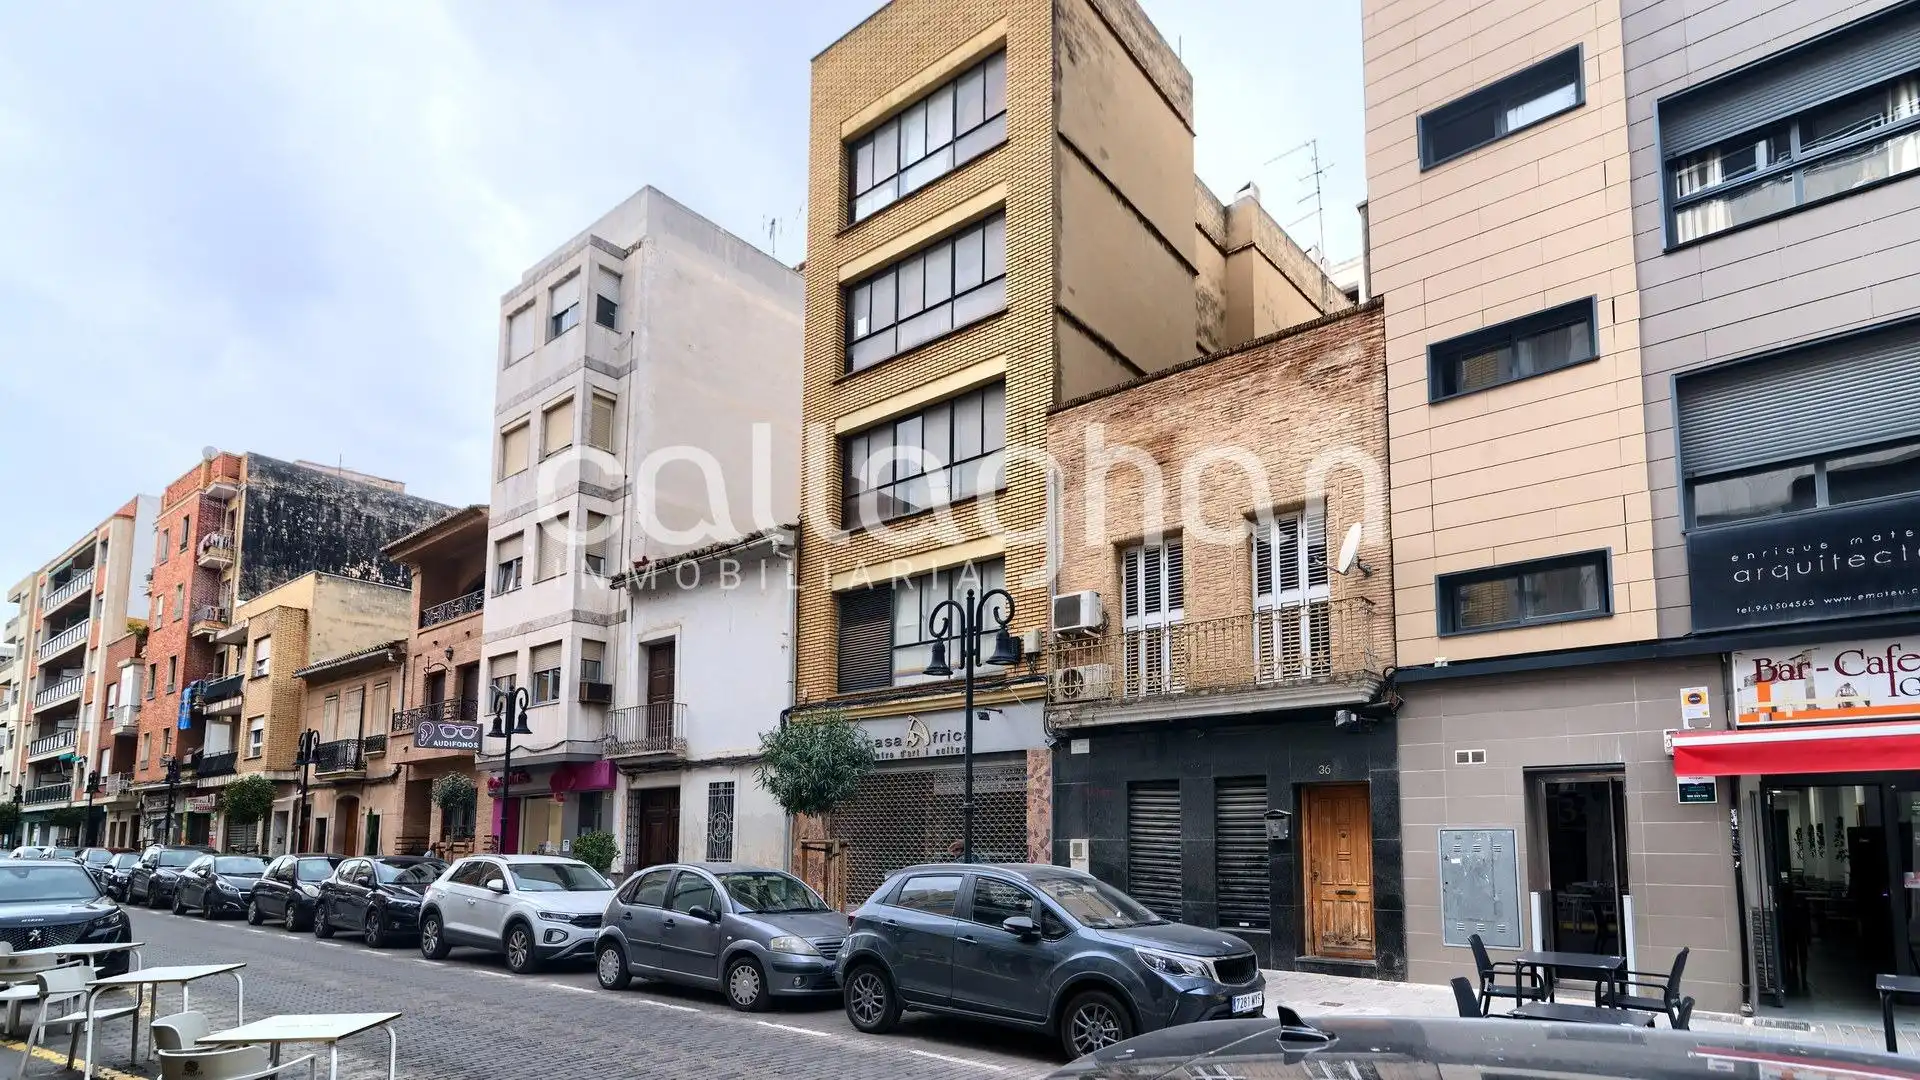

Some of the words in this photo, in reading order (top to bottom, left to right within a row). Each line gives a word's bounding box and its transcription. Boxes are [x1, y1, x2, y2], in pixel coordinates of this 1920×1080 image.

[1731, 541, 1828, 562] enrique
[1850, 529, 1914, 545] mate
[1733, 543, 1920, 583] arquitect
[433, 740, 479, 749] AUDIFONOS
[875, 737, 902, 749] asa
[1318, 765, 1331, 775] 36
